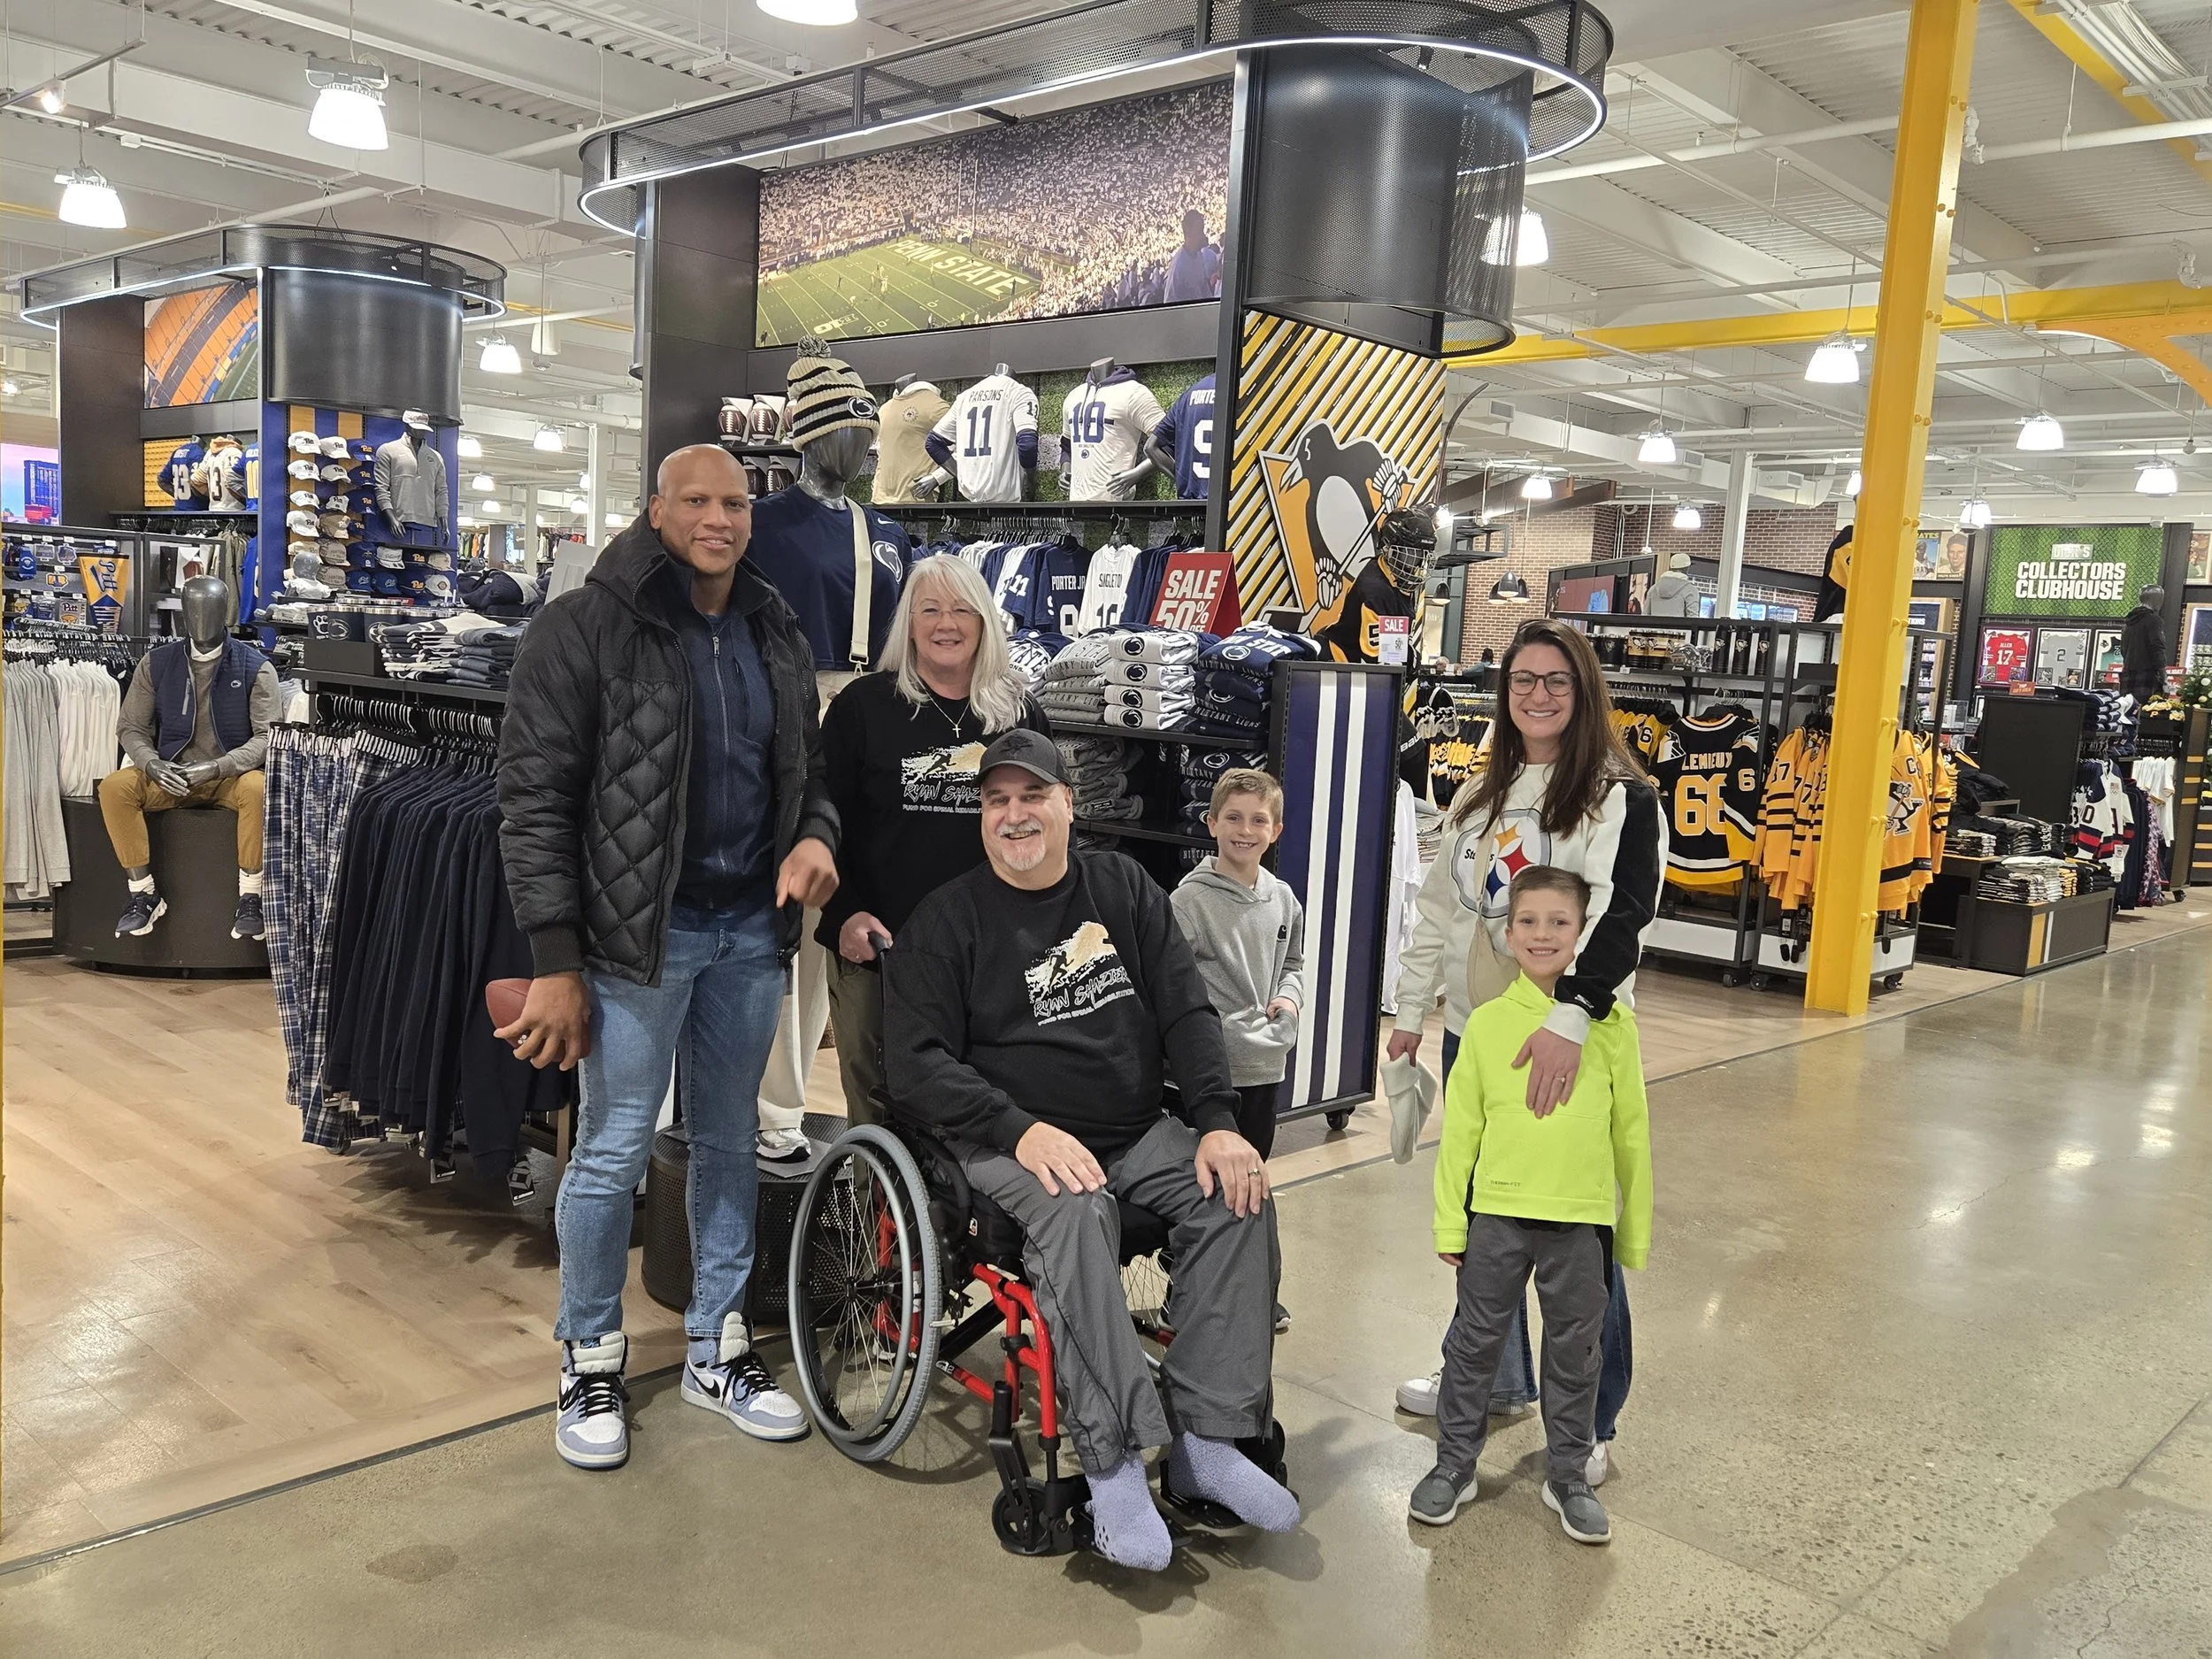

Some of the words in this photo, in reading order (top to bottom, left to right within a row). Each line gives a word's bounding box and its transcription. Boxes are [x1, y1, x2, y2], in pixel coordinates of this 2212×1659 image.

[886, 239, 948, 263] PENN
[933, 256, 1030, 296] STATE
[969, 389, 1003, 403] PARSONS
[964, 405, 993, 457] 11
[2016, 562, 2127, 580] COLLECTORS
[1051, 576, 1076, 590] PORTER
[1164, 570, 1222, 599] SALE
[2015, 580, 2124, 600] CLUBHOUSE
[62, 602, 78, 612] Pitt
[1384, 619, 1403, 632] SALE
[1996, 649, 2014, 665] 17
[2056, 649, 2066, 662] 2
[1194, 706, 1231, 723] NITTANY
[1640, 726, 1653, 743] 6
[1906, 757, 1917, 775] C
[1738, 768, 1757, 792] 6
[903, 780, 941, 803] RYAN
[1033, 988, 1070, 1018] RYAN
[1074, 965, 1132, 1007] SHAZIER
[1071, 1006, 1094, 1018] SPINAL
